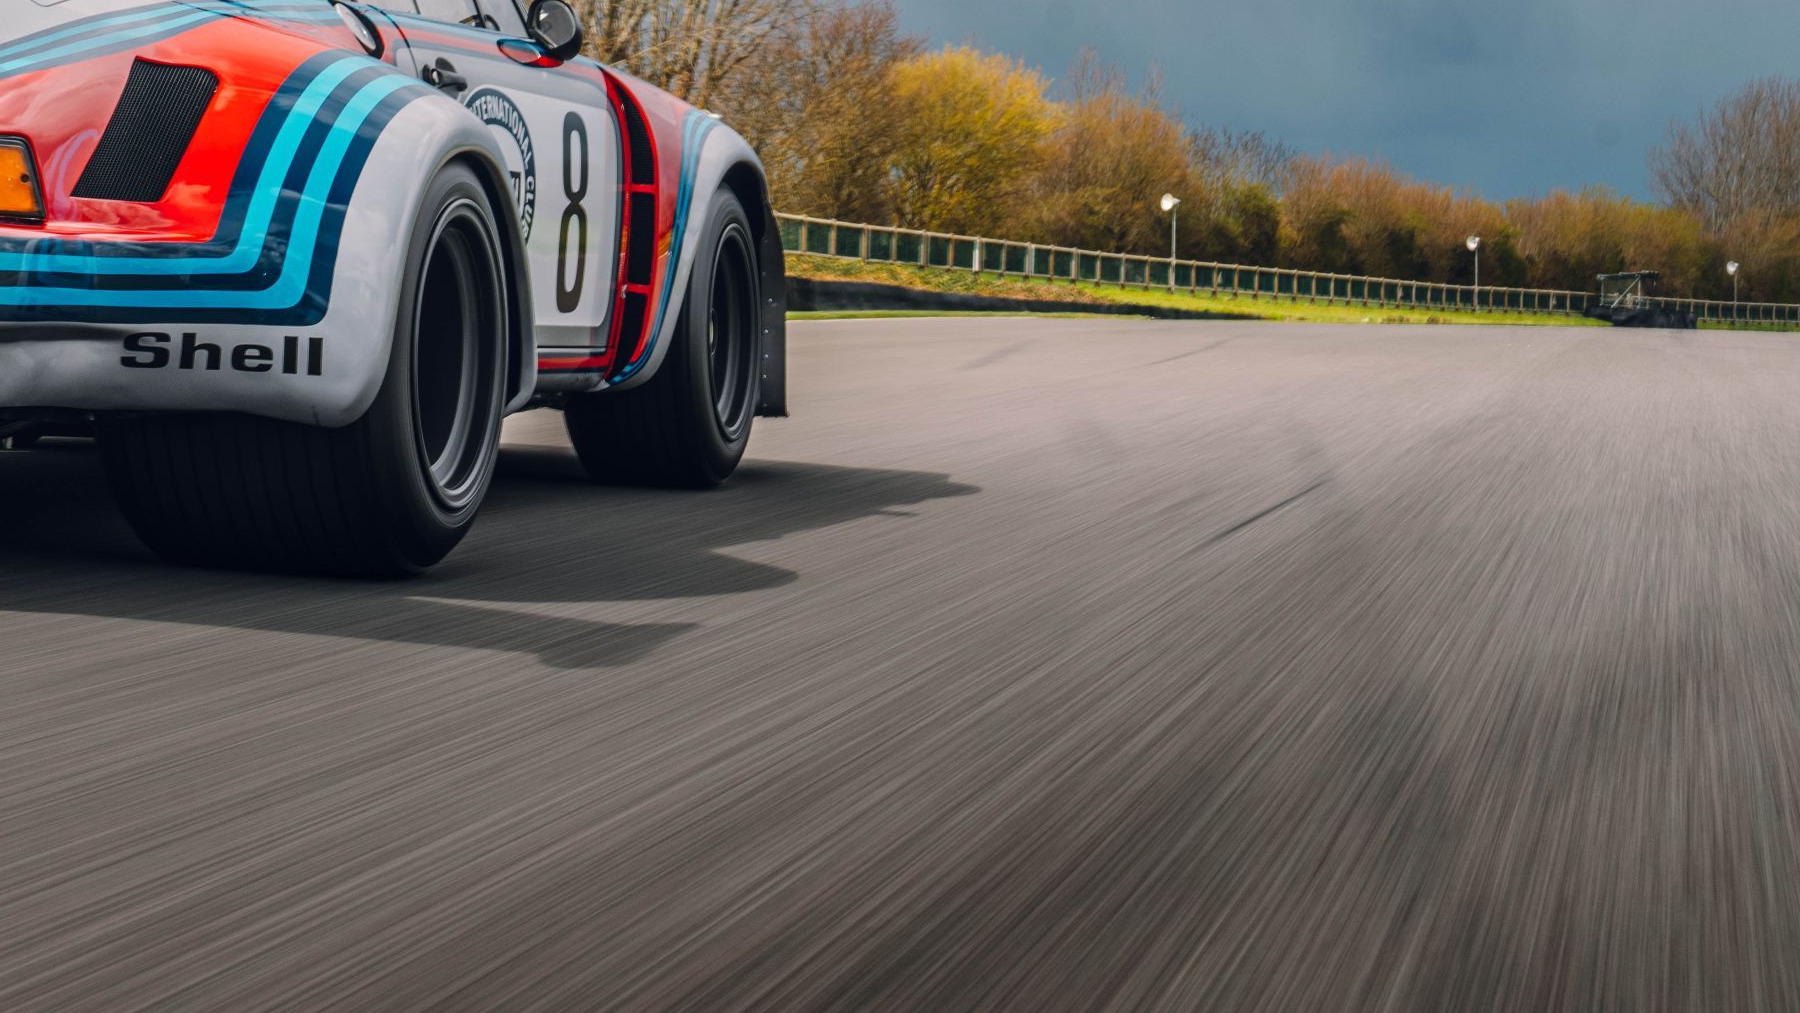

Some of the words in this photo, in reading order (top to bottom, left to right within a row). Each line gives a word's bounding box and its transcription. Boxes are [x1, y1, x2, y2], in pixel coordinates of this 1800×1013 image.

[469, 94, 534, 171] NTERNATIONAL
[556, 111, 589, 314] 8
[120, 331, 324, 376] Shell
